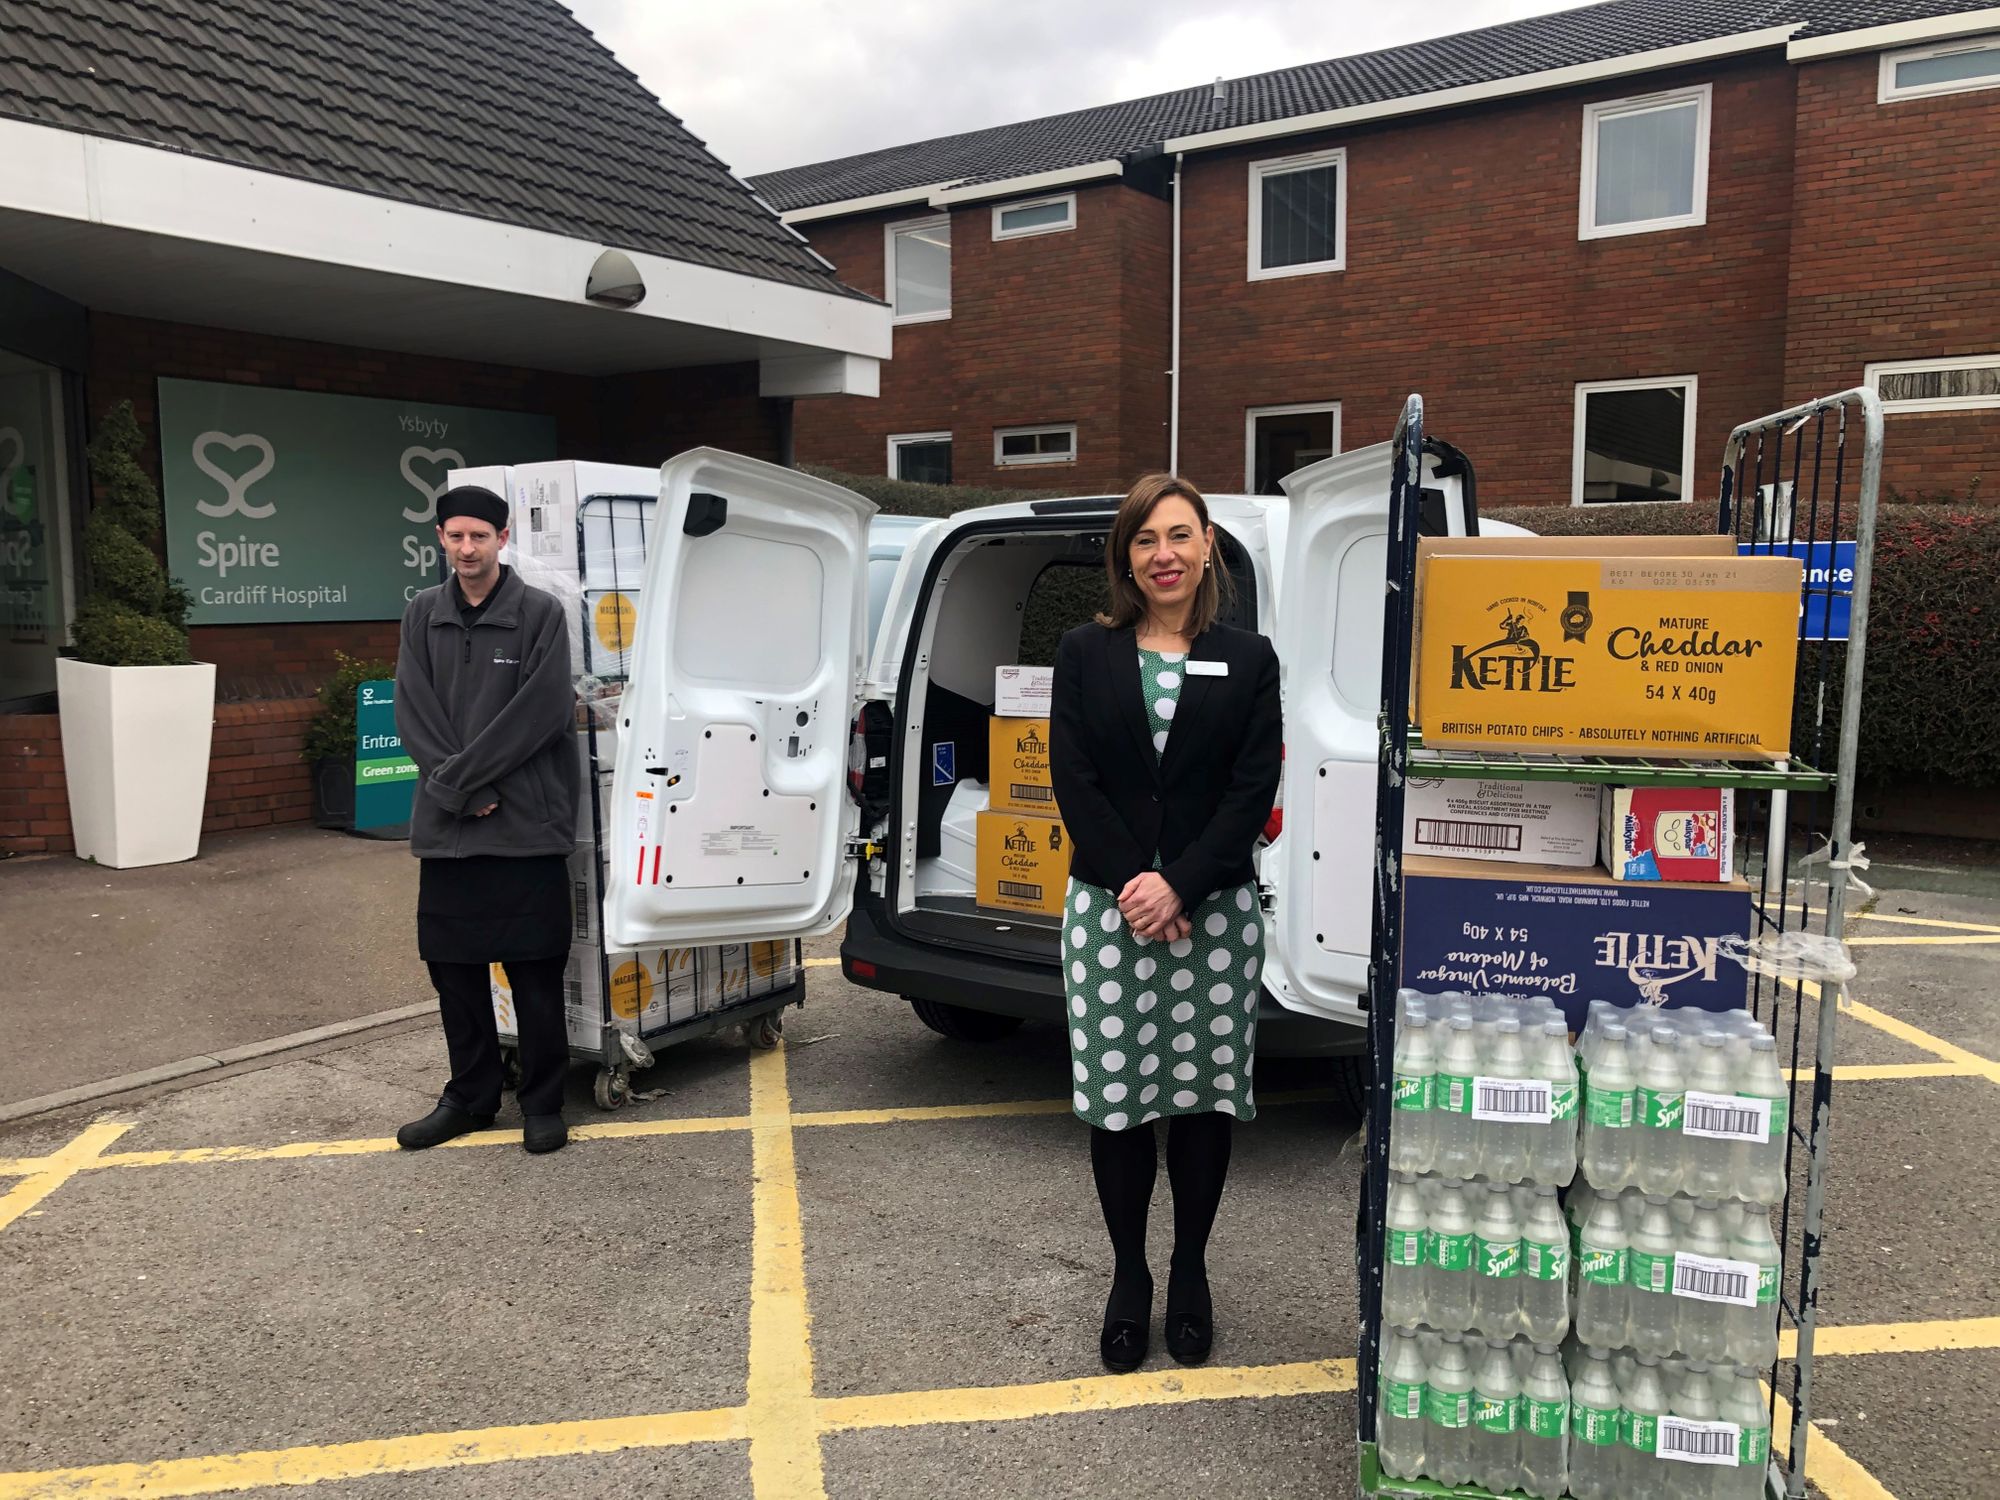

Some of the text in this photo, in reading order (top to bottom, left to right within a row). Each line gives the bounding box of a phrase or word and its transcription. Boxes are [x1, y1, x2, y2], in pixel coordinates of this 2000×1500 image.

[398, 415, 449, 439] Ysbyty
[196, 530, 280, 578] Spire
[1640, 570, 1678, 578] BEFORE
[1700, 571, 1719, 579] Jan
[1801, 567, 1853, 583] ance
[200, 585, 348, 609] Cardiff Hospital
[1659, 617, 1710, 630] MATURE
[1607, 626, 1763, 661] Cheddar
[1450, 639, 1577, 693] KETTLE
[1640, 660, 1724, 674] & RED ONION
[1645, 684, 1717, 705] 54 X 40g
[362, 734, 401, 750] Entra
[1441, 722, 1482, 735] BRITISH
[1487, 723, 1527, 737] POTATO
[1532, 725, 1564, 738] CHIPS
[1578, 727, 1647, 741] ABSOLUTELY
[1651, 730, 1700, 743] NOTHING
[1704, 732, 1762, 746] ARTIFICIAL
[1016, 736, 1048, 754] KETTLE
[362, 763, 420, 778] Green zone
[1013, 757, 1050, 769] Cheddar
[1477, 780, 1524, 793] Traditional
[1487, 789, 1523, 800] Delicious
[1449, 808, 1488, 816] CONFERENCES
[1473, 805, 1508, 813] ASSORTMENT
[1490, 800, 1526, 809] ASSORTMENT
[1623, 814, 1635, 852] Milkybar
[1684, 818, 1693, 850] Milkybar
[1004, 834, 1037, 853] KETTLE
[1001, 855, 1039, 868] Cheddar
[1720, 861, 1728, 874] Bags
[1574, 896, 1598, 905] BARNARD
[1612, 899, 1630, 907] FOODS
[1631, 900, 1650, 908] KETTLE
[1462, 921, 1528, 942] 54 X 40g
[1443, 950, 1549, 972] of Modena
[1592, 931, 1719, 985] KETTLE
[1416, 965, 1581, 995] Balsamic Vinegar
[1392, 1082, 1420, 1101] prite
[1655, 1103, 1683, 1128] Spri
[1487, 1248, 1521, 1277] Sprit
[1474, 1403, 1504, 1424] prite
